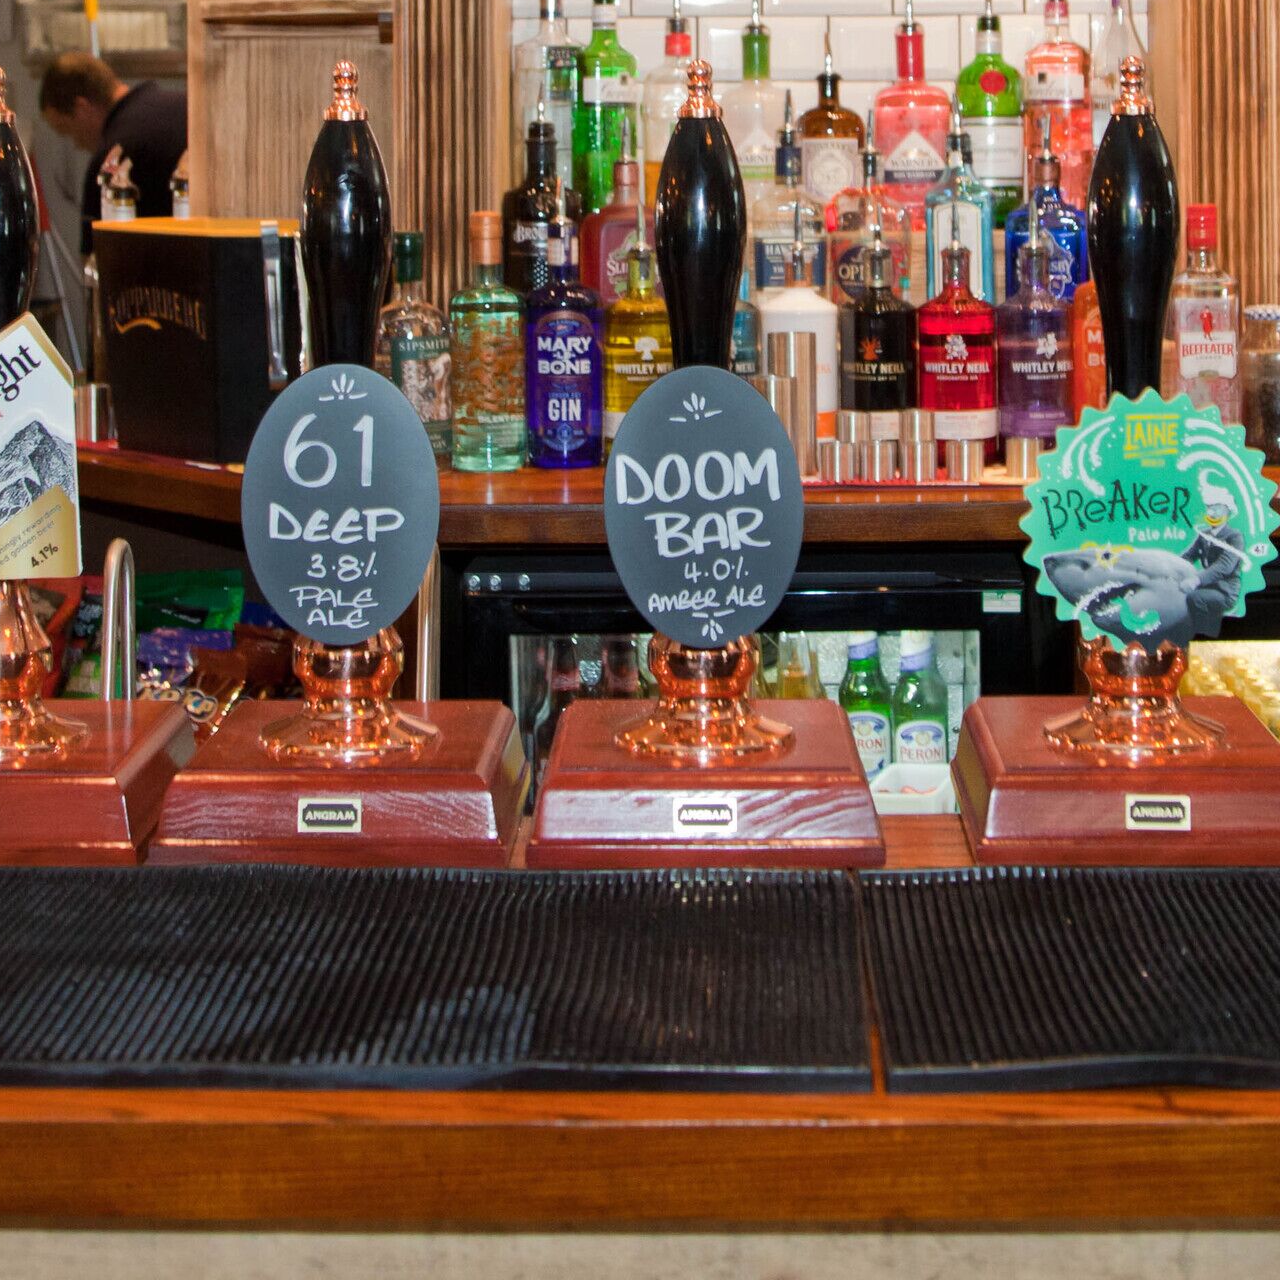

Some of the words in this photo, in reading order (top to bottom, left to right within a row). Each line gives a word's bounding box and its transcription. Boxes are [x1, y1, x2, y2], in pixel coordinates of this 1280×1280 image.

[537, 336, 592, 354] MARY
[1182, 344, 1233, 357] BEEFEATER
[537, 360, 591, 375] BONE
[613, 363, 654, 375] WHITLEY
[880, 362, 905, 374] NEILL
[924, 362, 964, 374] WHITLEY
[965, 362, 990, 374] NEILL
[1012, 360, 1055, 373] WHITLEY
[548, 399, 581, 422] GIN
[1123, 421, 1179, 451] LAINE
[283, 412, 374, 488] 61
[615, 448, 781, 505] DOOM
[270, 502, 405, 544] DEEP
[644, 506, 771, 558] BAR
[1129, 527, 1162, 542] Pale
[1163, 526, 1187, 540] Ale
[31, 543, 59, 568] 4.1%
[289, 586, 379, 608] PALE
[648, 589, 721, 613] AMBER
[725, 584, 766, 607] ALE
[307, 608, 370, 629] ALE
[856, 738, 887, 750] RONI
[900, 745, 945, 761] PERONI
[303, 810, 356, 821] ANGRAM
[1133, 805, 1184, 818] ANGRAM
